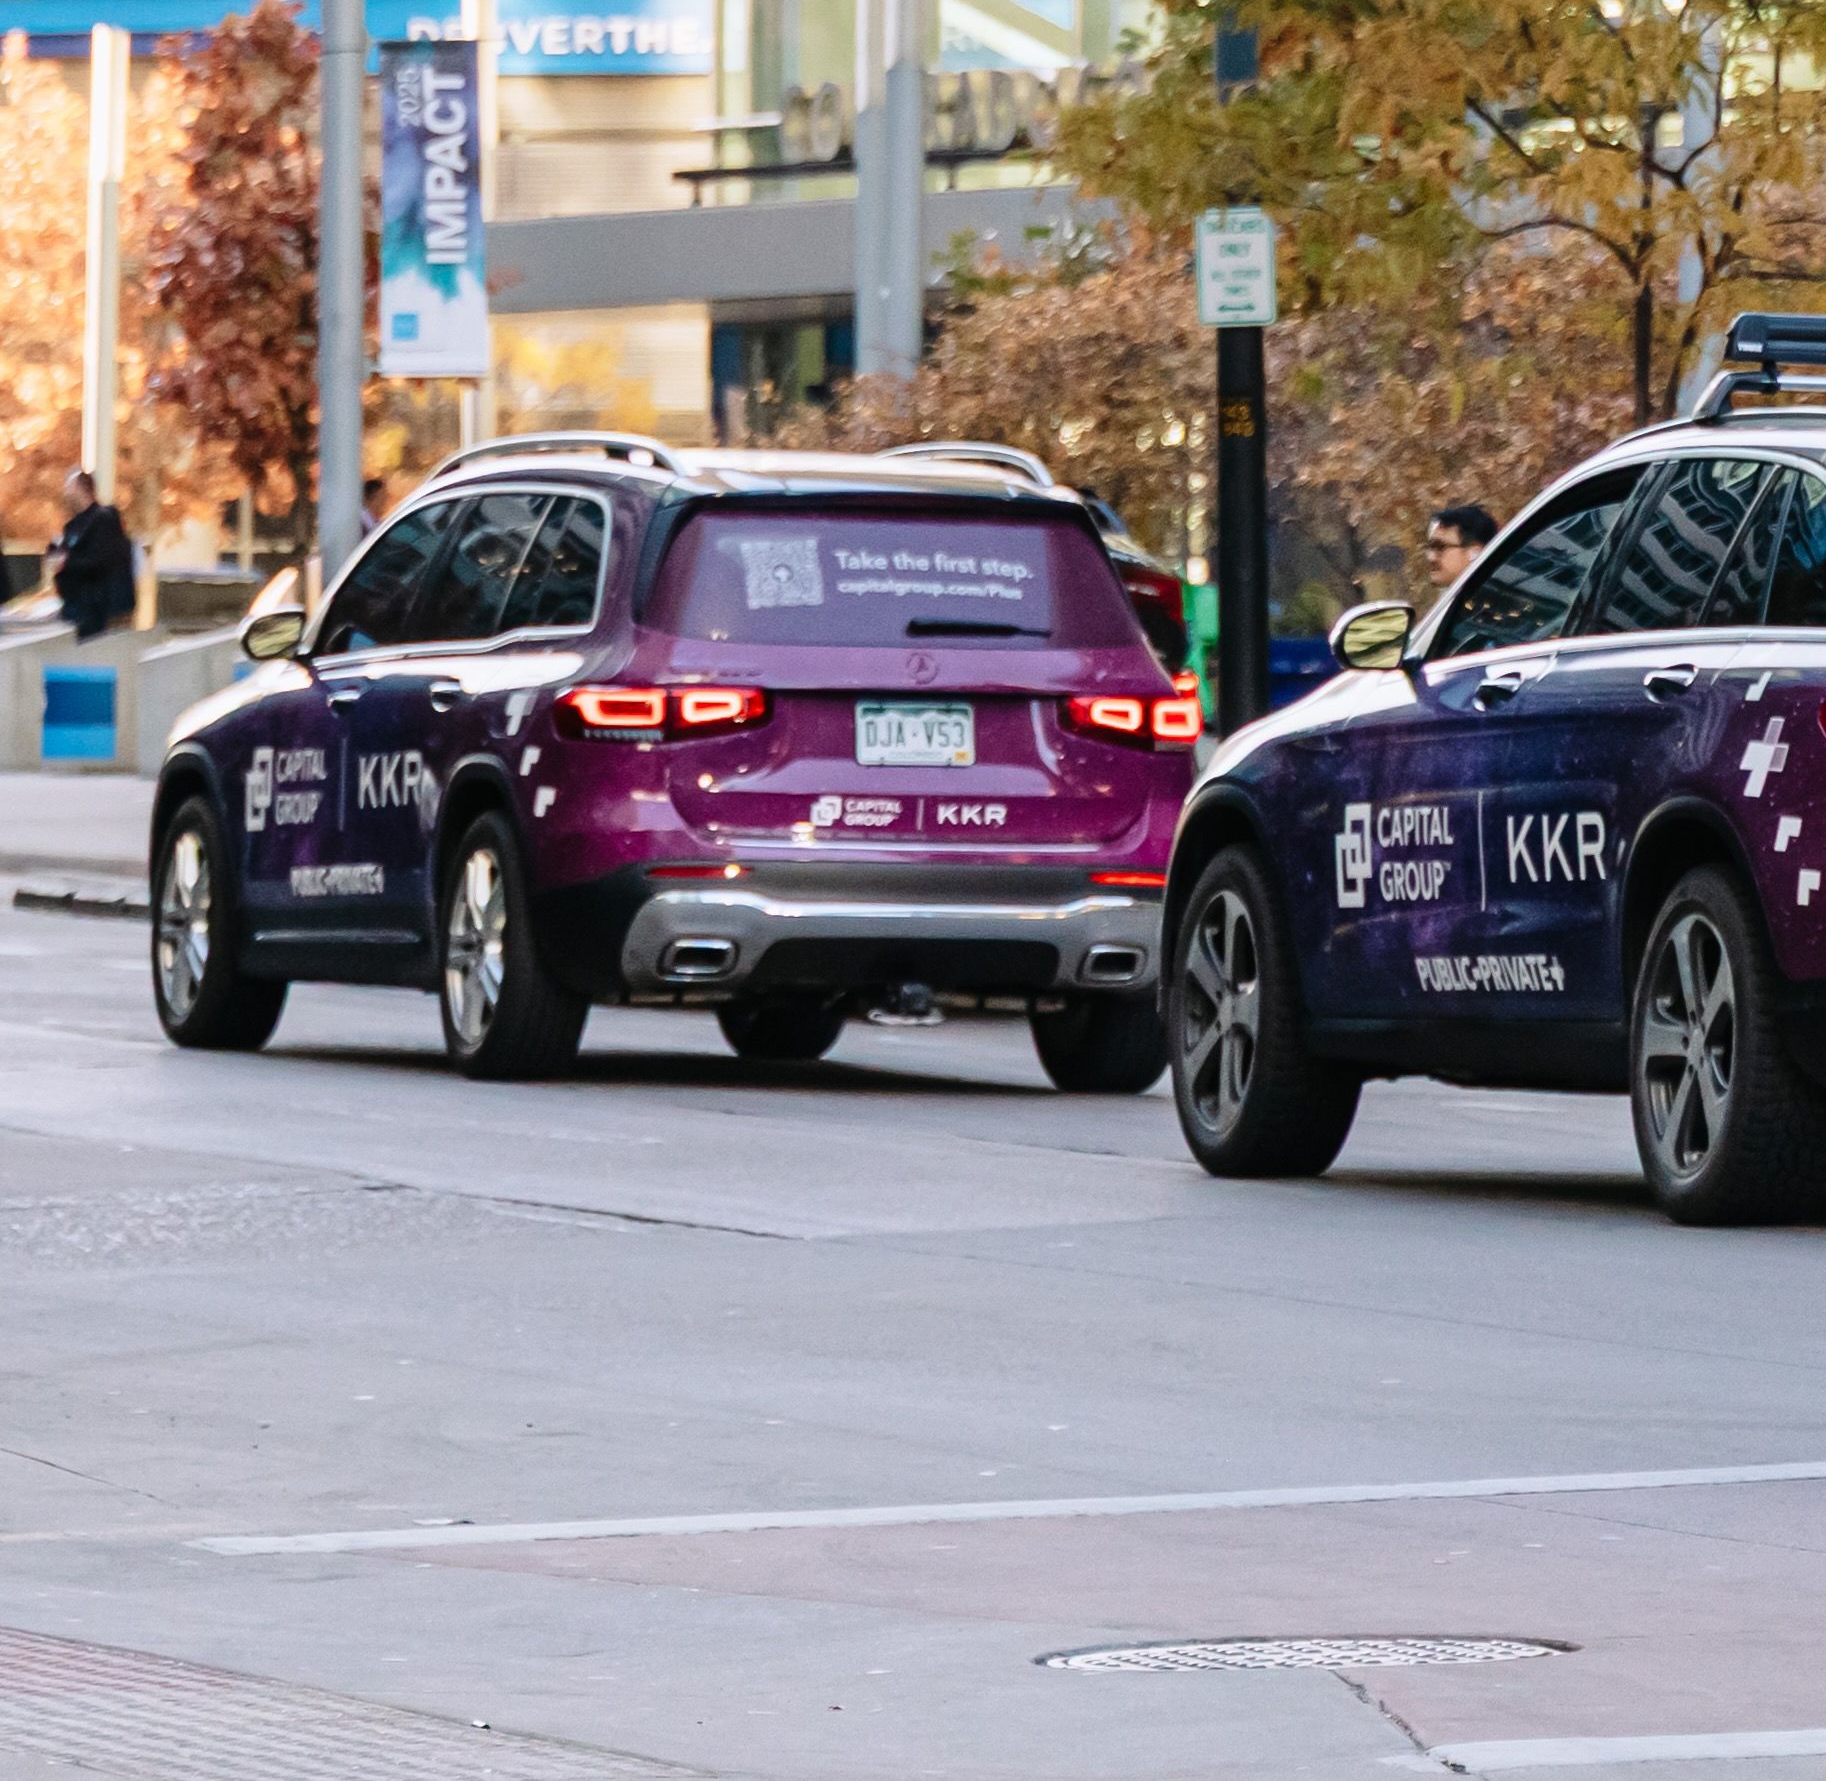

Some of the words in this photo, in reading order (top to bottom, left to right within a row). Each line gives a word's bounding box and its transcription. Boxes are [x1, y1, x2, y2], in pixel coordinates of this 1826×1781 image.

[400, 63, 422, 126] 2025
[424, 65, 467, 265] IMPACT
[834, 548, 888, 570] Take
[893, 550, 929, 571] the
[934, 550, 977, 574] first
[981, 557, 1034, 582] step.
[358, 750, 422, 809] KKR
[845, 799, 902, 814] CAPITAL
[937, 803, 1007, 826] KKR
[1377, 806, 1454, 848] CAPITAL
[1507, 812, 1606, 883] KKR
